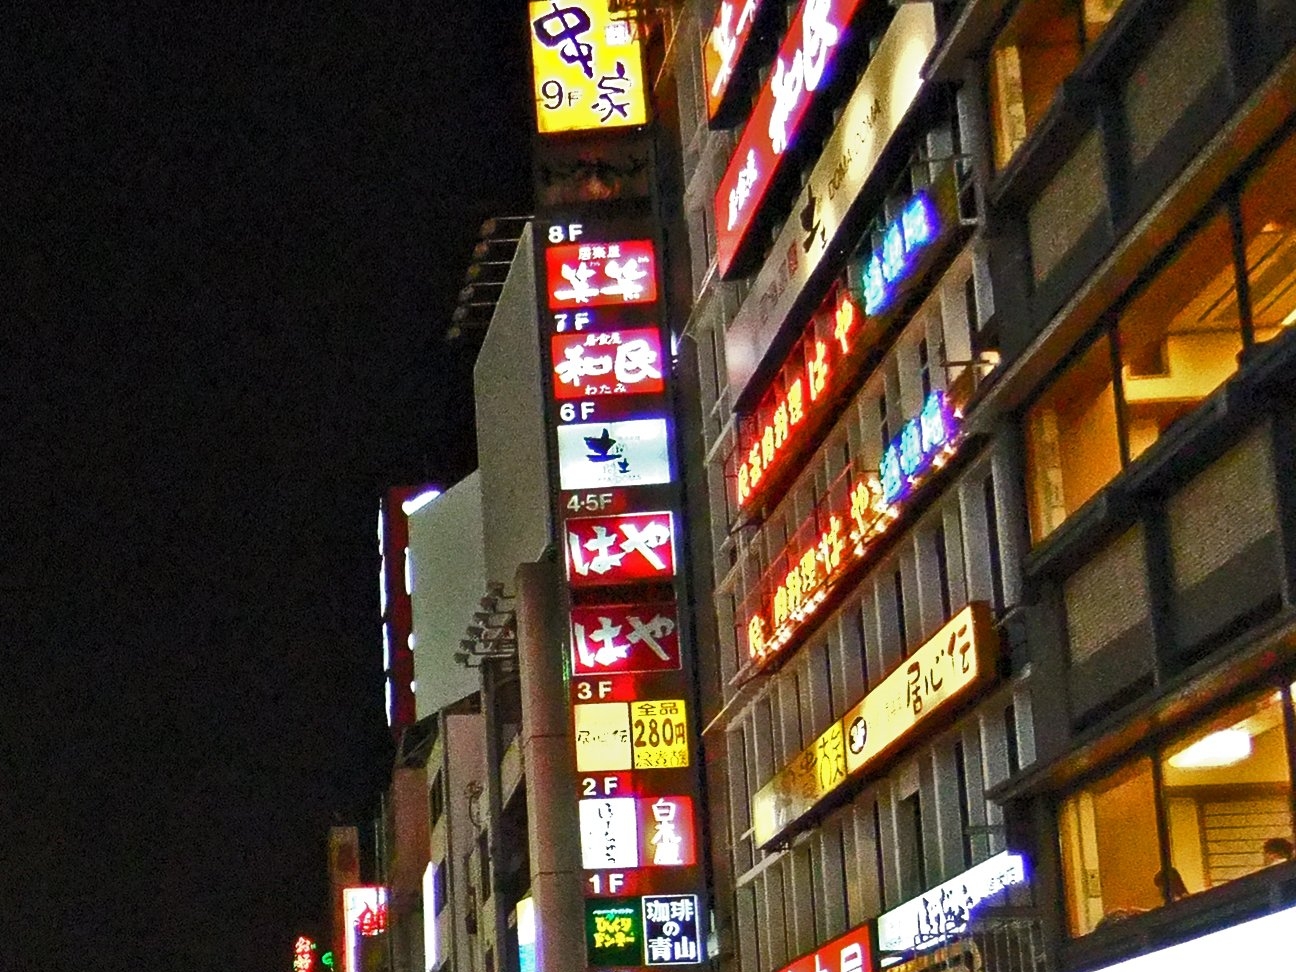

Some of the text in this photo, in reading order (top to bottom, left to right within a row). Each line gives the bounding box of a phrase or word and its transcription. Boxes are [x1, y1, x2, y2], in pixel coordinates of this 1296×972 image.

[541, 80, 581, 110] 9F
[548, 222, 583, 243] 8F
[554, 311, 590, 332] 7F
[554, 338, 662, 387] 和民
[584, 383, 627, 395] わたみ
[559, 402, 595, 422] 6F
[568, 520, 672, 577] はや
[574, 614, 675, 668] はや
[577, 680, 613, 700] 3F
[638, 703, 679, 717] 全品
[634, 718, 686, 748] 280円
[582, 777, 618, 796] 2F
[589, 873, 624, 894] 1F
[646, 899, 694, 923] 珈琲
[662, 920, 681, 937] の
[648, 936, 696, 962] 青山
